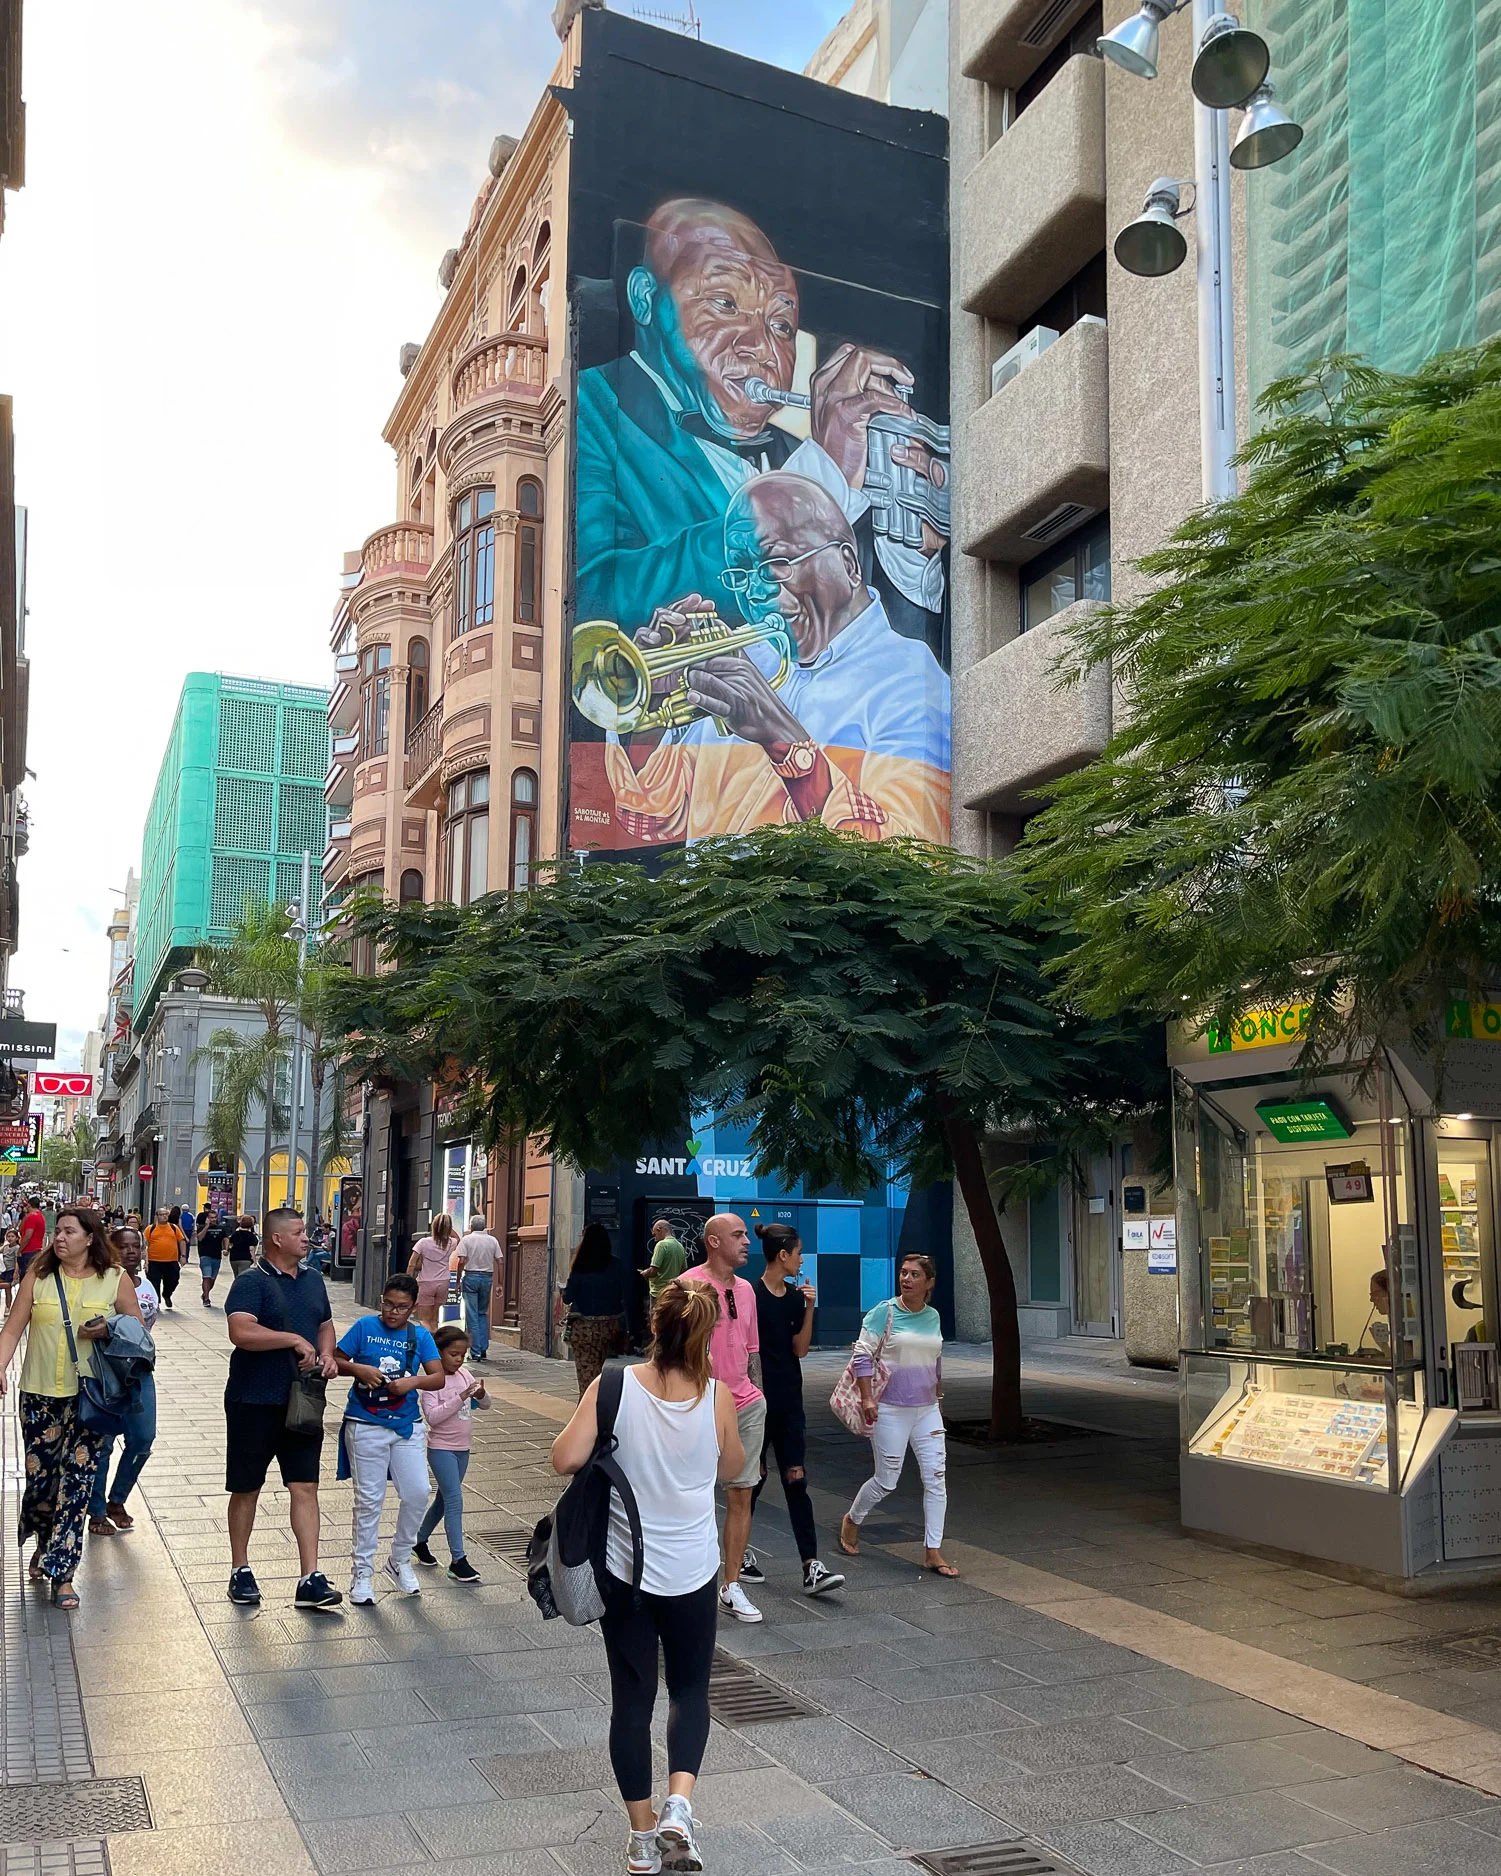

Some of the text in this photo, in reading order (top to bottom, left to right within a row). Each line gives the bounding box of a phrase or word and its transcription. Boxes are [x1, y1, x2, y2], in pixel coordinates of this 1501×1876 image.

[574, 807, 602, 817] SABOTAJE
[584, 816, 610, 824] MONTAJE
[1270, 1112, 1328, 1125] PAGO CON TARJETA
[1286, 1123, 1325, 1133] DISPONIBLE
[702, 1159, 751, 1177] CRUZ
[1345, 1180, 1361, 1191] 49
[367, 1335, 391, 1346] THINK
